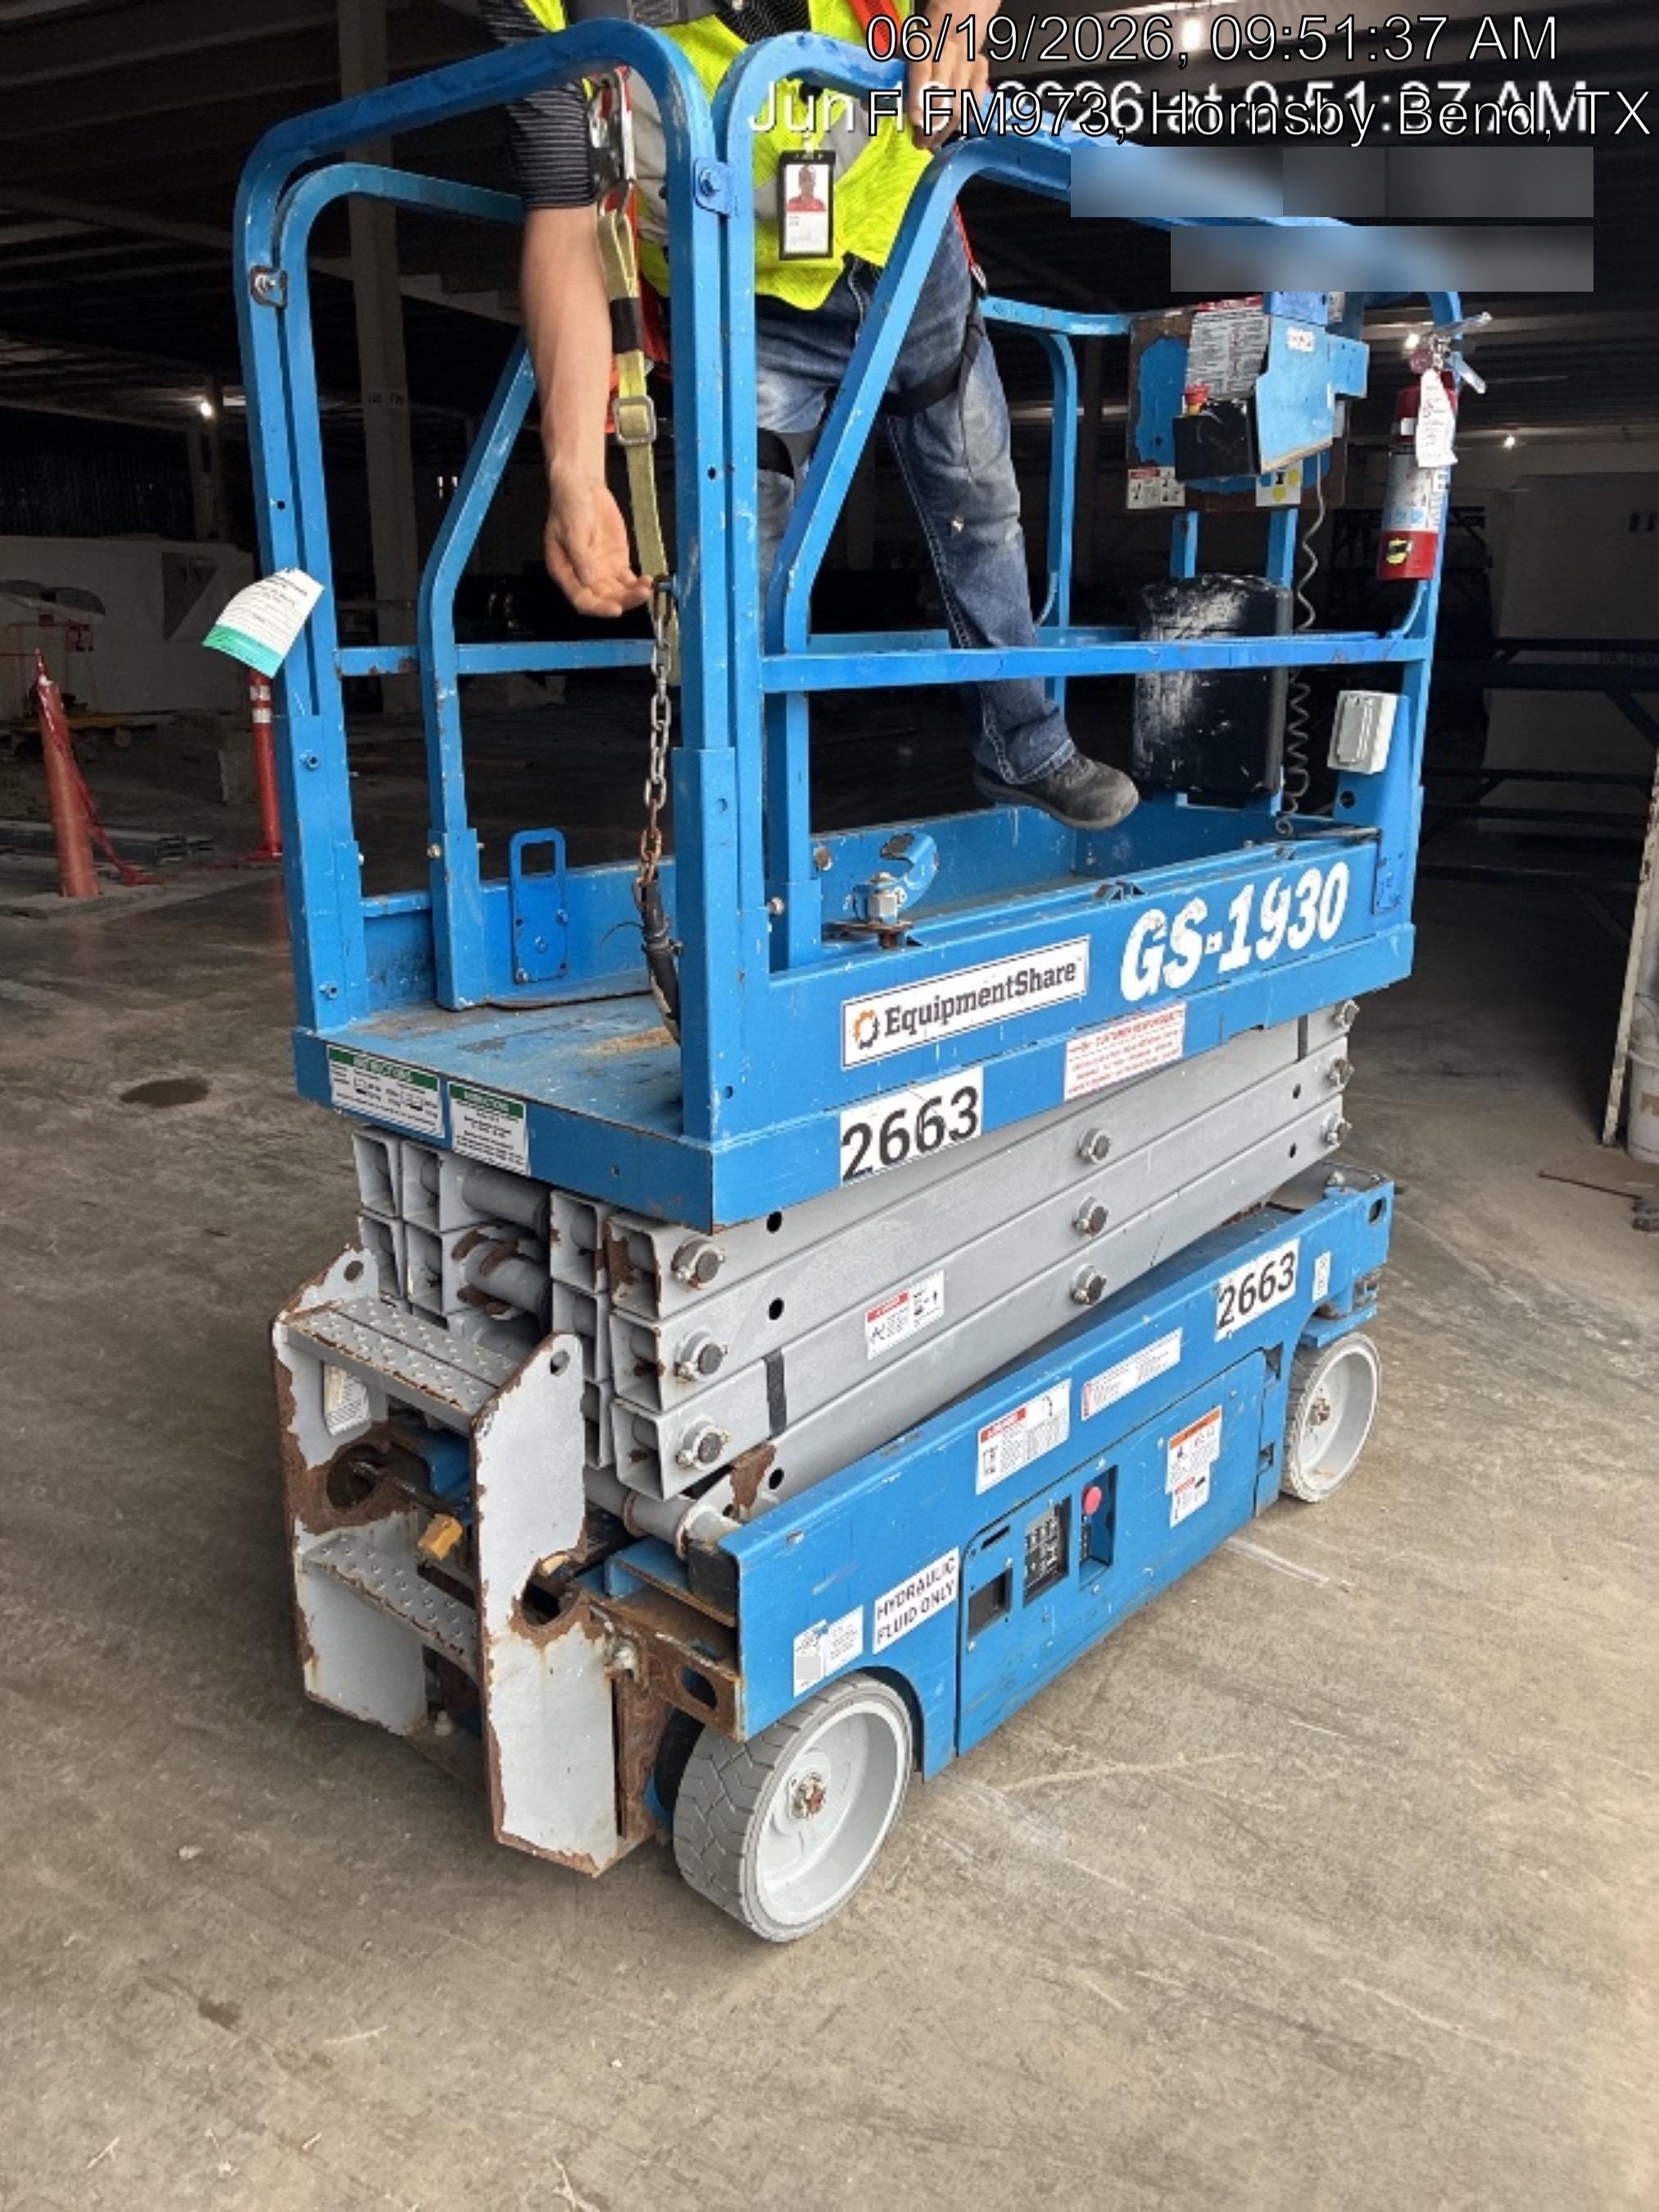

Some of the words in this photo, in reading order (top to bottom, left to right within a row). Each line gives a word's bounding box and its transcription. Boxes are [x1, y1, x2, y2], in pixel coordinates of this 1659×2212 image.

[1120, 861, 1349, 1001] GS-1930
[884, 962, 1076, 1037] EquipmentShare
[841, 1086, 978, 1181] 2663
[1217, 1250, 1295, 1330] 2663
[877, 1556, 955, 1620] HYDRAULIC
[877, 1607, 918, 1646] FLUID
[920, 1580, 955, 1615] ONLY
